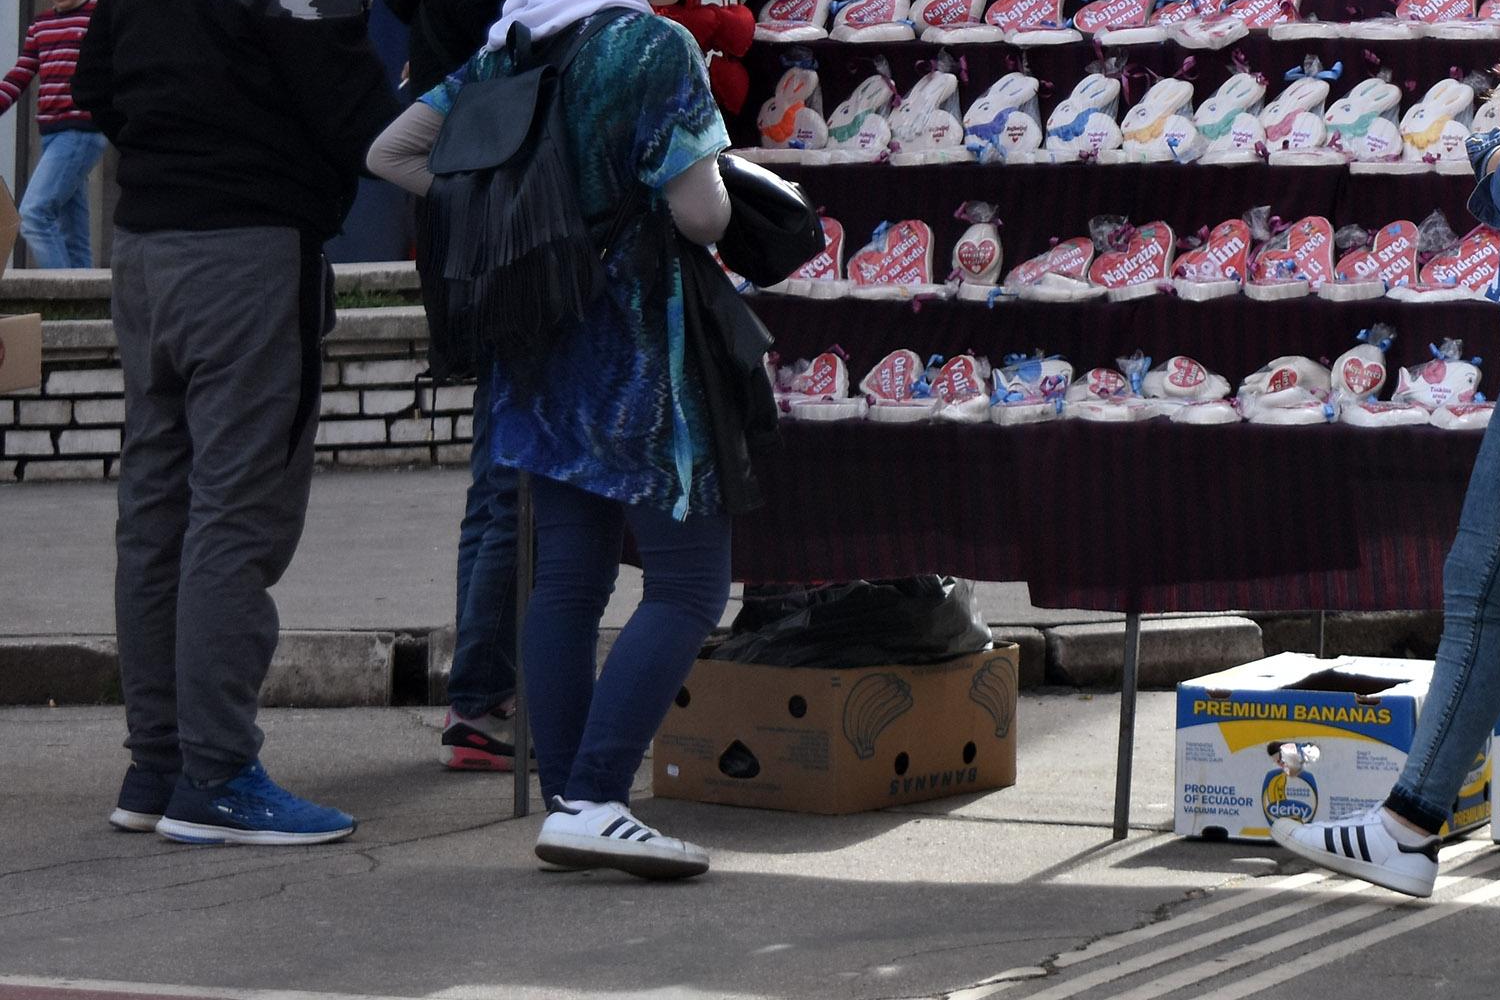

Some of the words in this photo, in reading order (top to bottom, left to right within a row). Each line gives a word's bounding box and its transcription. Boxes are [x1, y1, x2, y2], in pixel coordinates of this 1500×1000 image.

[799, 252, 833, 280] srcu
[1101, 237, 1165, 286] Najdražoj
[1354, 256, 1380, 277] Od
[1378, 236, 1410, 264] srca
[1432, 241, 1500, 284] Najdražoj
[1459, 262, 1496, 289] osobi
[1192, 700, 1288, 720] PREMIUM
[1292, 705, 1393, 726] BANANAS
[889, 767, 978, 796] BANANAS
[1184, 783, 1236, 796] PRODUCE
[1183, 806, 1218, 816] VACUUM
[1217, 807, 1240, 817] PACK
[1184, 794, 1199, 804] OF
[1201, 795, 1254, 807] ECUADOR
[1269, 802, 1309, 819] derby
